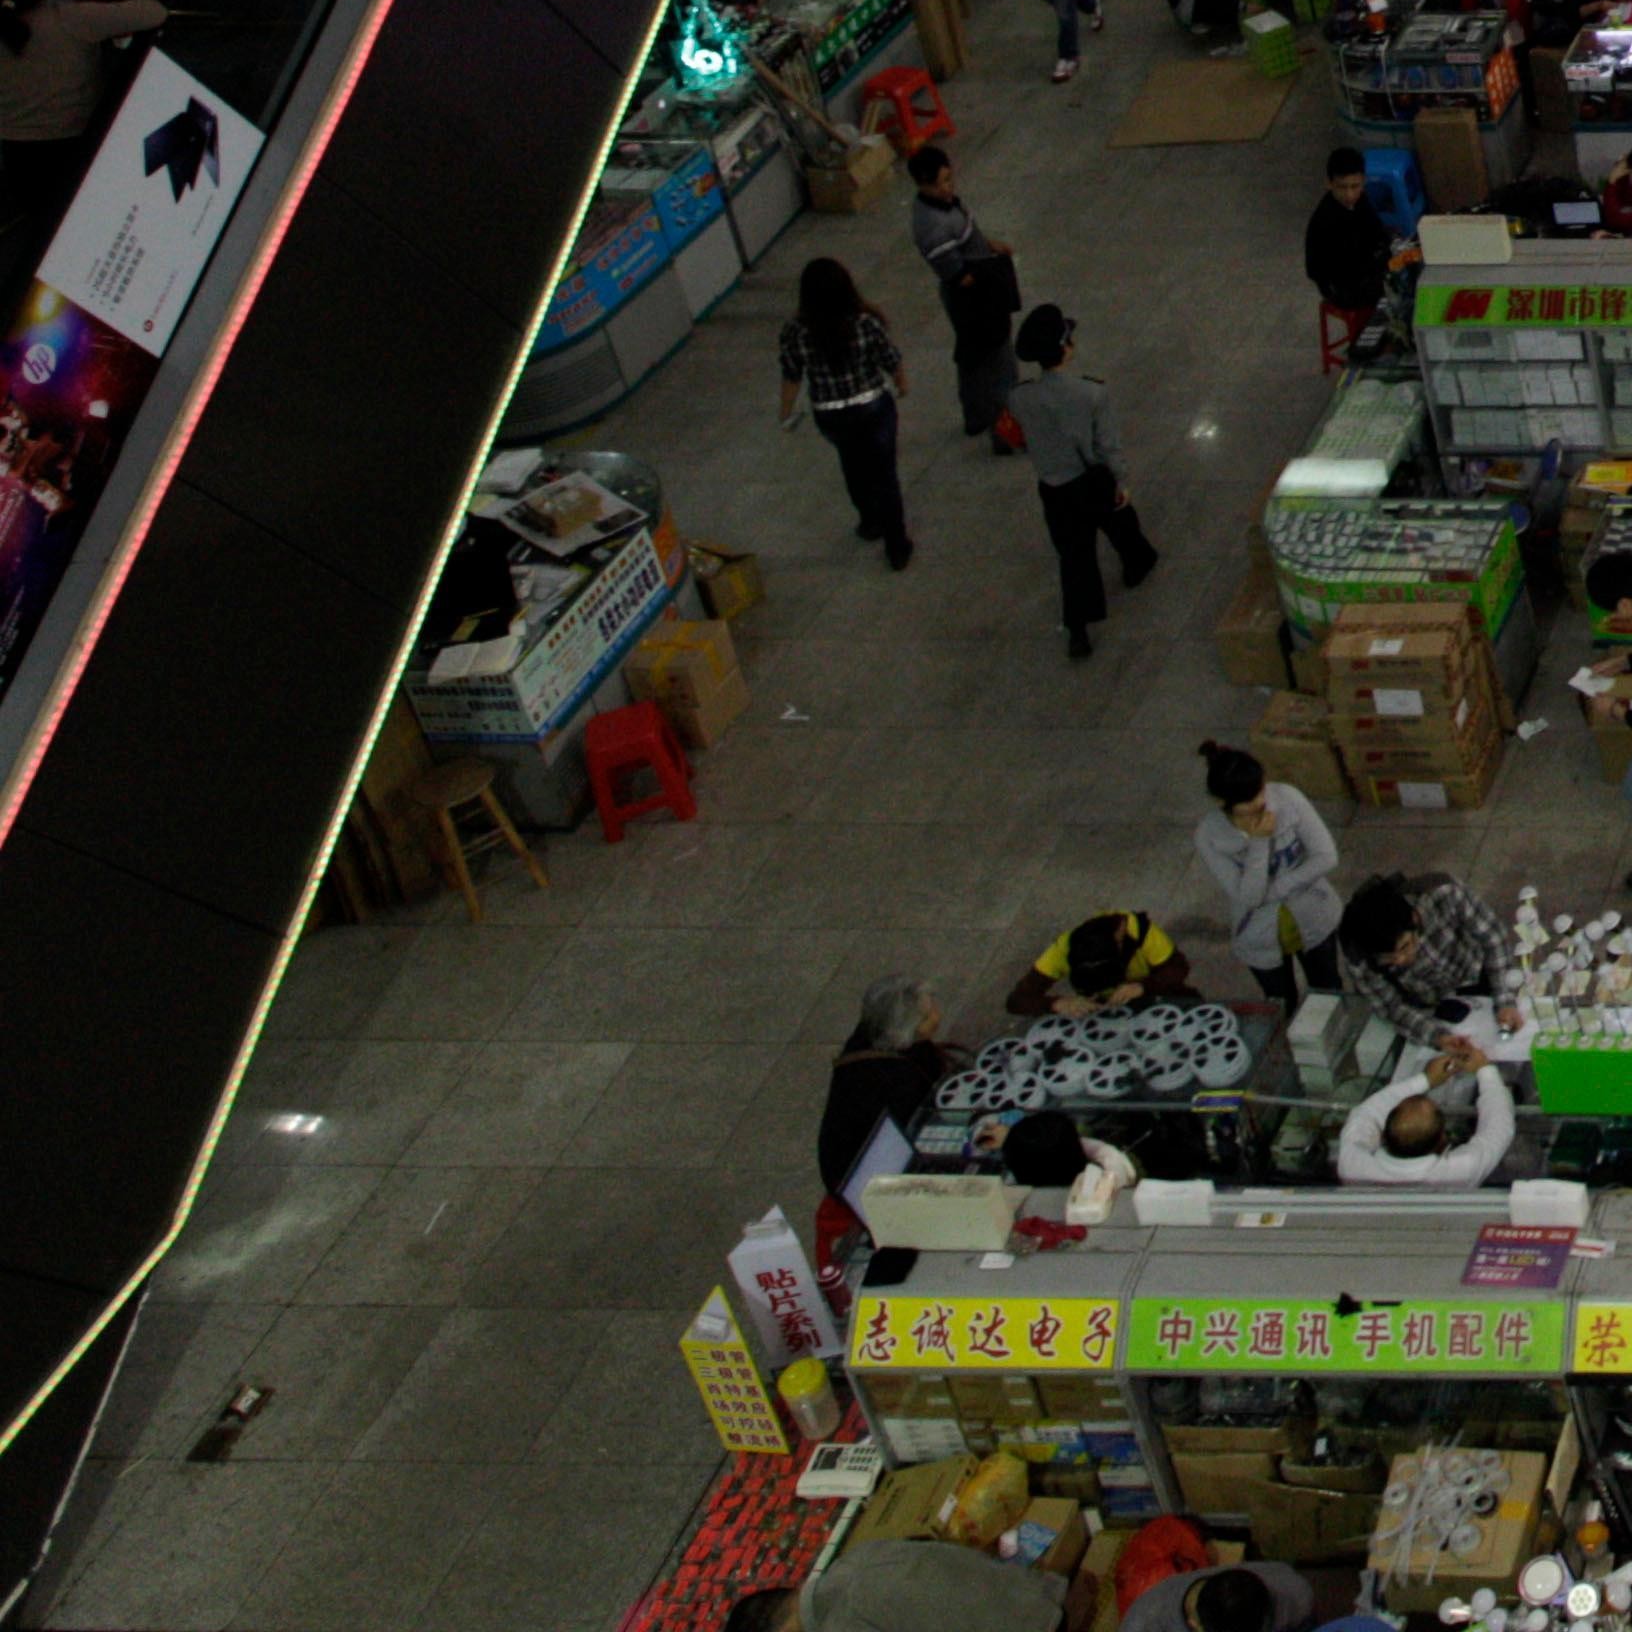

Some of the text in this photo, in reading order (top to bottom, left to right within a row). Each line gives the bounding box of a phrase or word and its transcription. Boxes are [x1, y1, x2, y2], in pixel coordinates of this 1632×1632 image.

[754, 1268, 822, 1354] 贴片系列
[858, 1301, 1113, 1364] 志诚达电子
[1157, 1309, 1532, 1360] 中兴通讯 手机配件
[689, 1349, 747, 1364] 二极管
[699, 1366, 753, 1381] 三极管
